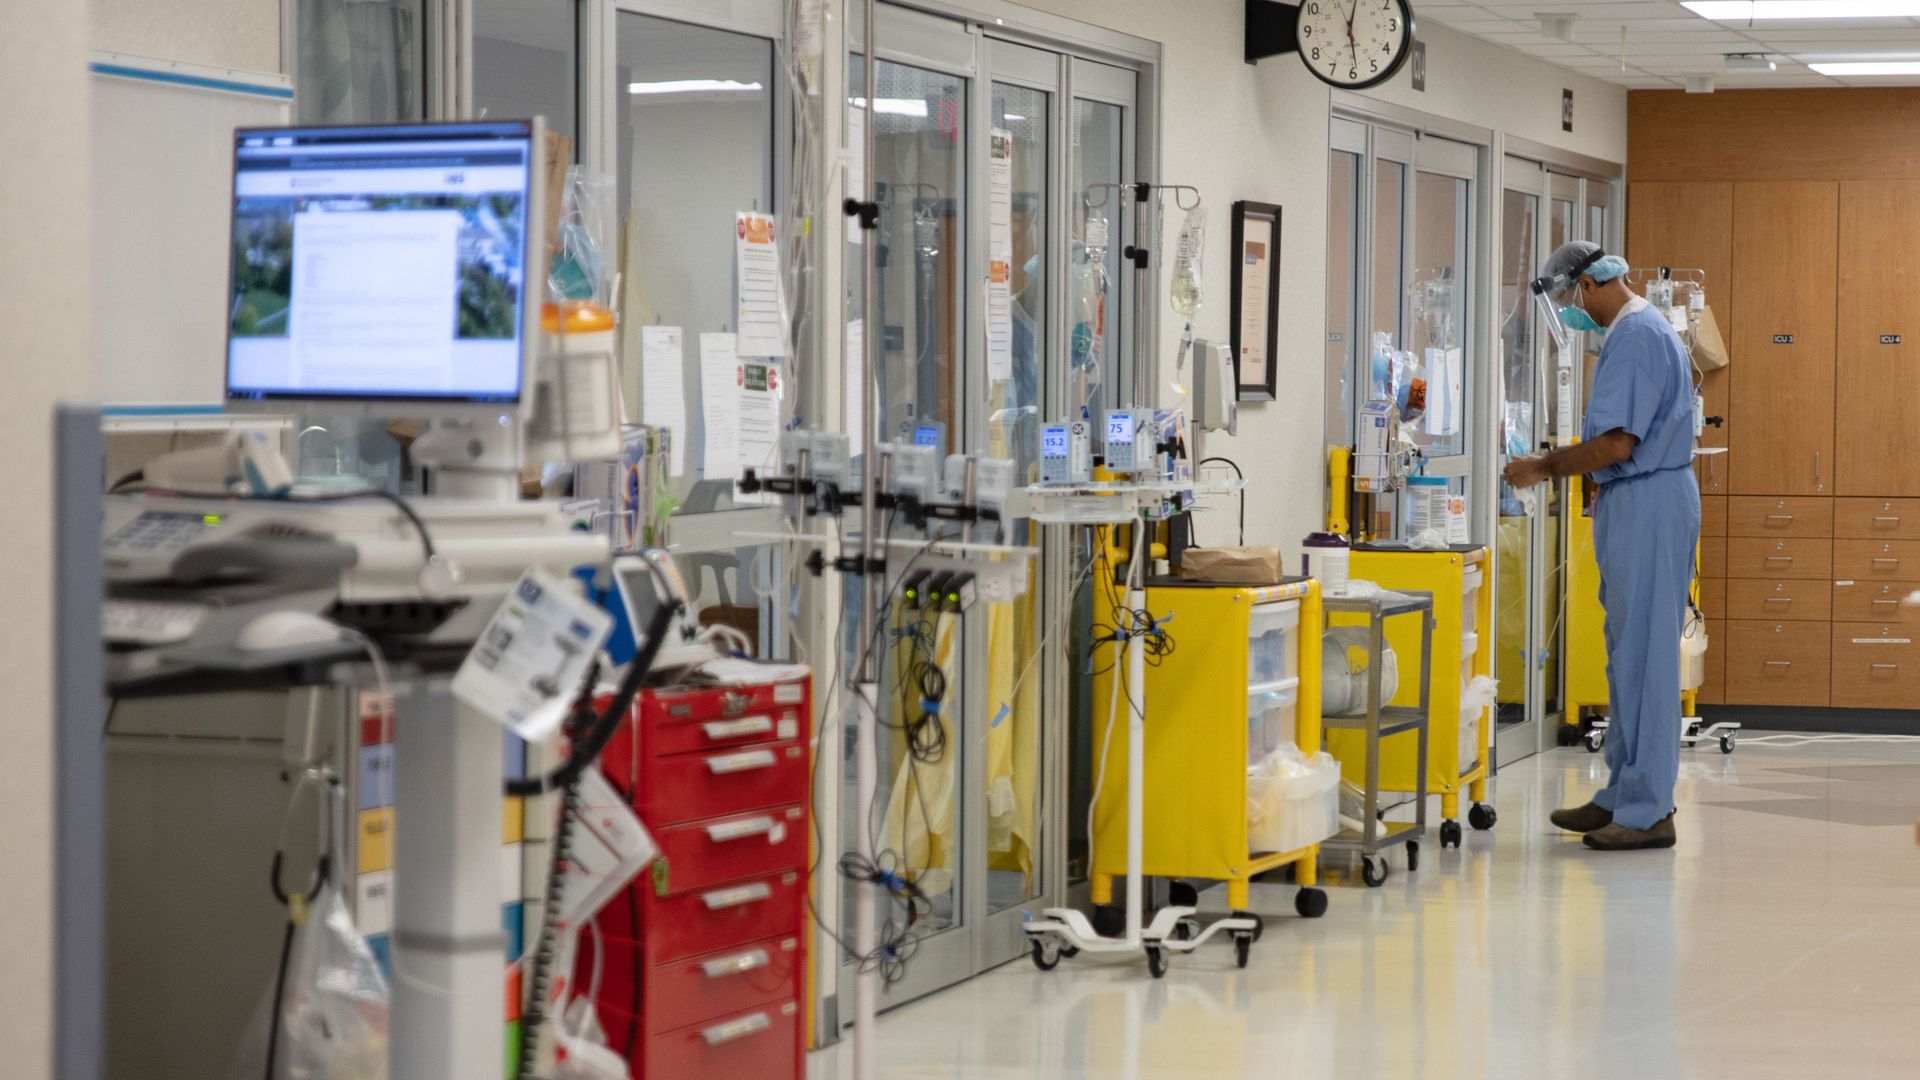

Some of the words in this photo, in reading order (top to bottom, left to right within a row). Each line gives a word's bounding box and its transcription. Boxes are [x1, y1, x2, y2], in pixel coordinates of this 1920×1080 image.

[1307, 2, 1319, 16] 10
[1383, 0, 1391, 10] 2
[1389, 18, 1397, 32] 3
[1303, 25, 1312, 39] 9
[1311, 47, 1320, 60] 8
[1382, 41, 1391, 55] 4
[1328, 63, 1337, 76] 7
[1349, 66, 1358, 80] 6
[1370, 60, 1378, 73] 5
[1774, 335, 1788, 343] ICU
[1880, 335, 1894, 343] ICU
[1894, 335, 1900, 343] 4
[1109, 423, 1123, 434] 75
[1044, 437, 1065, 447] 15.2
